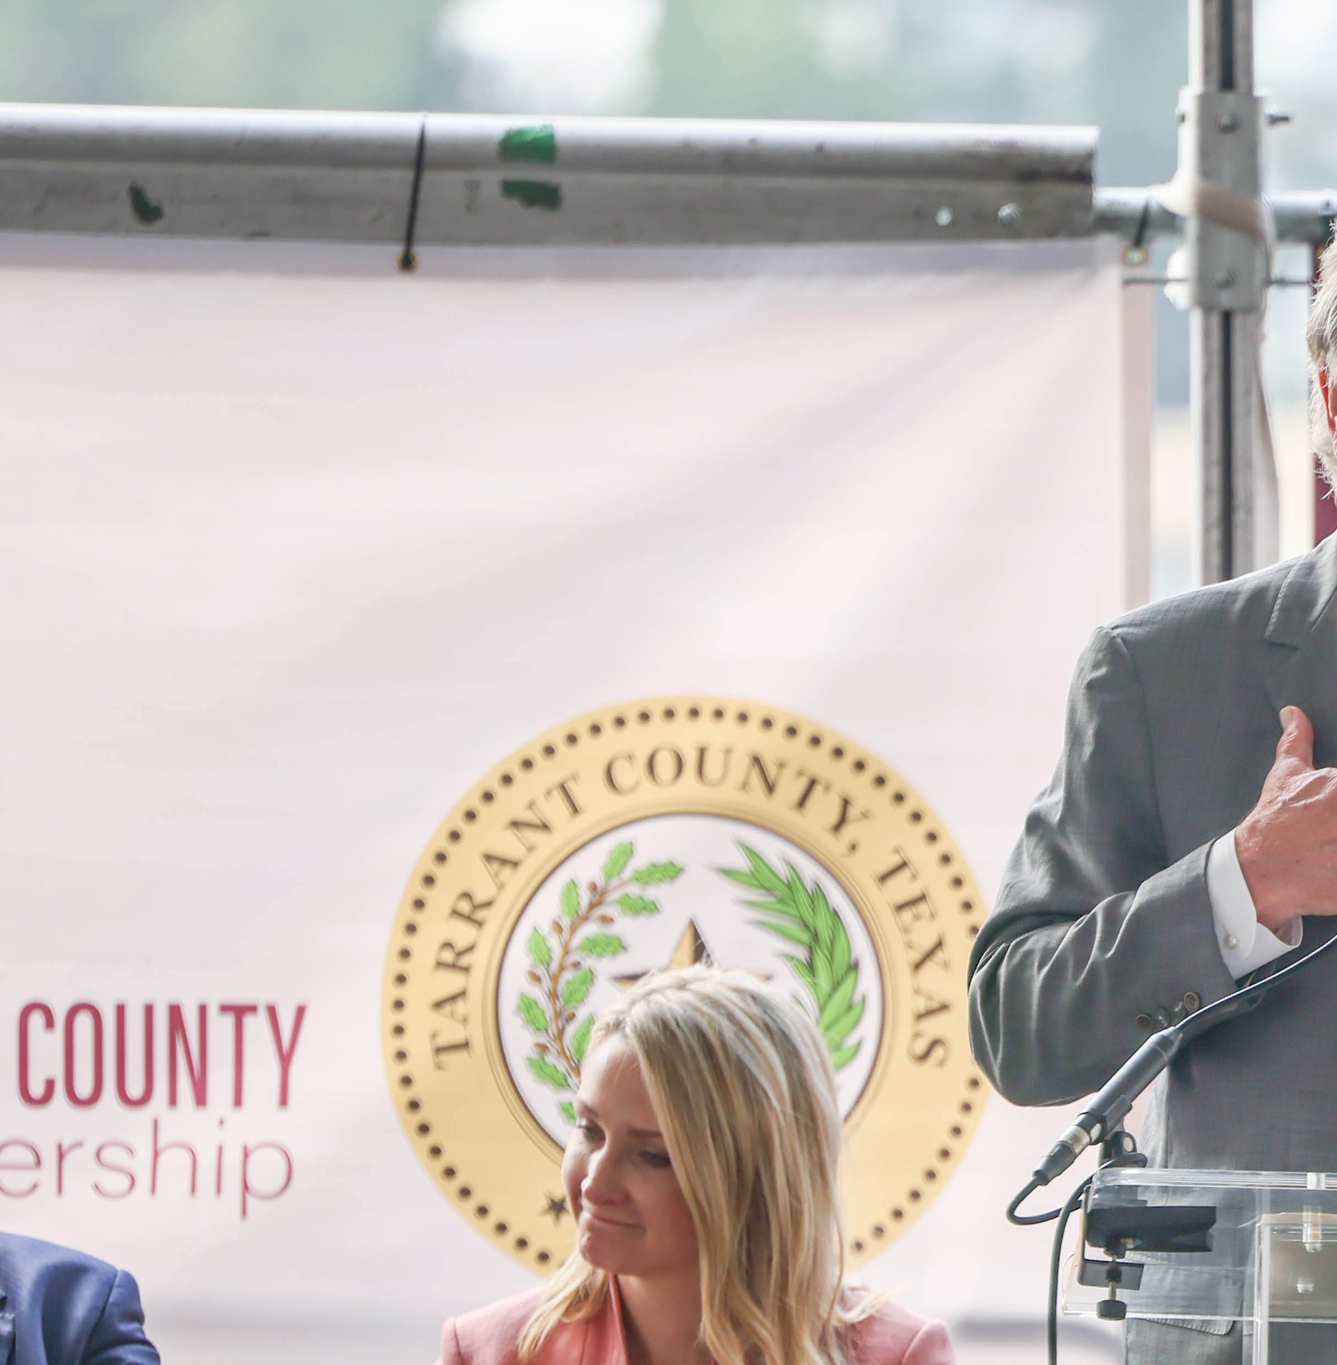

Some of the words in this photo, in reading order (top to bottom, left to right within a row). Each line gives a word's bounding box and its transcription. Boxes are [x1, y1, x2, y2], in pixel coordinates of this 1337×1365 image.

[427, 772, 582, 1070] TARRANT
[603, 744, 873, 857] COUNTY,
[874, 846, 951, 1069] TEXAS
[17, 1001, 307, 1108] COUNTY
